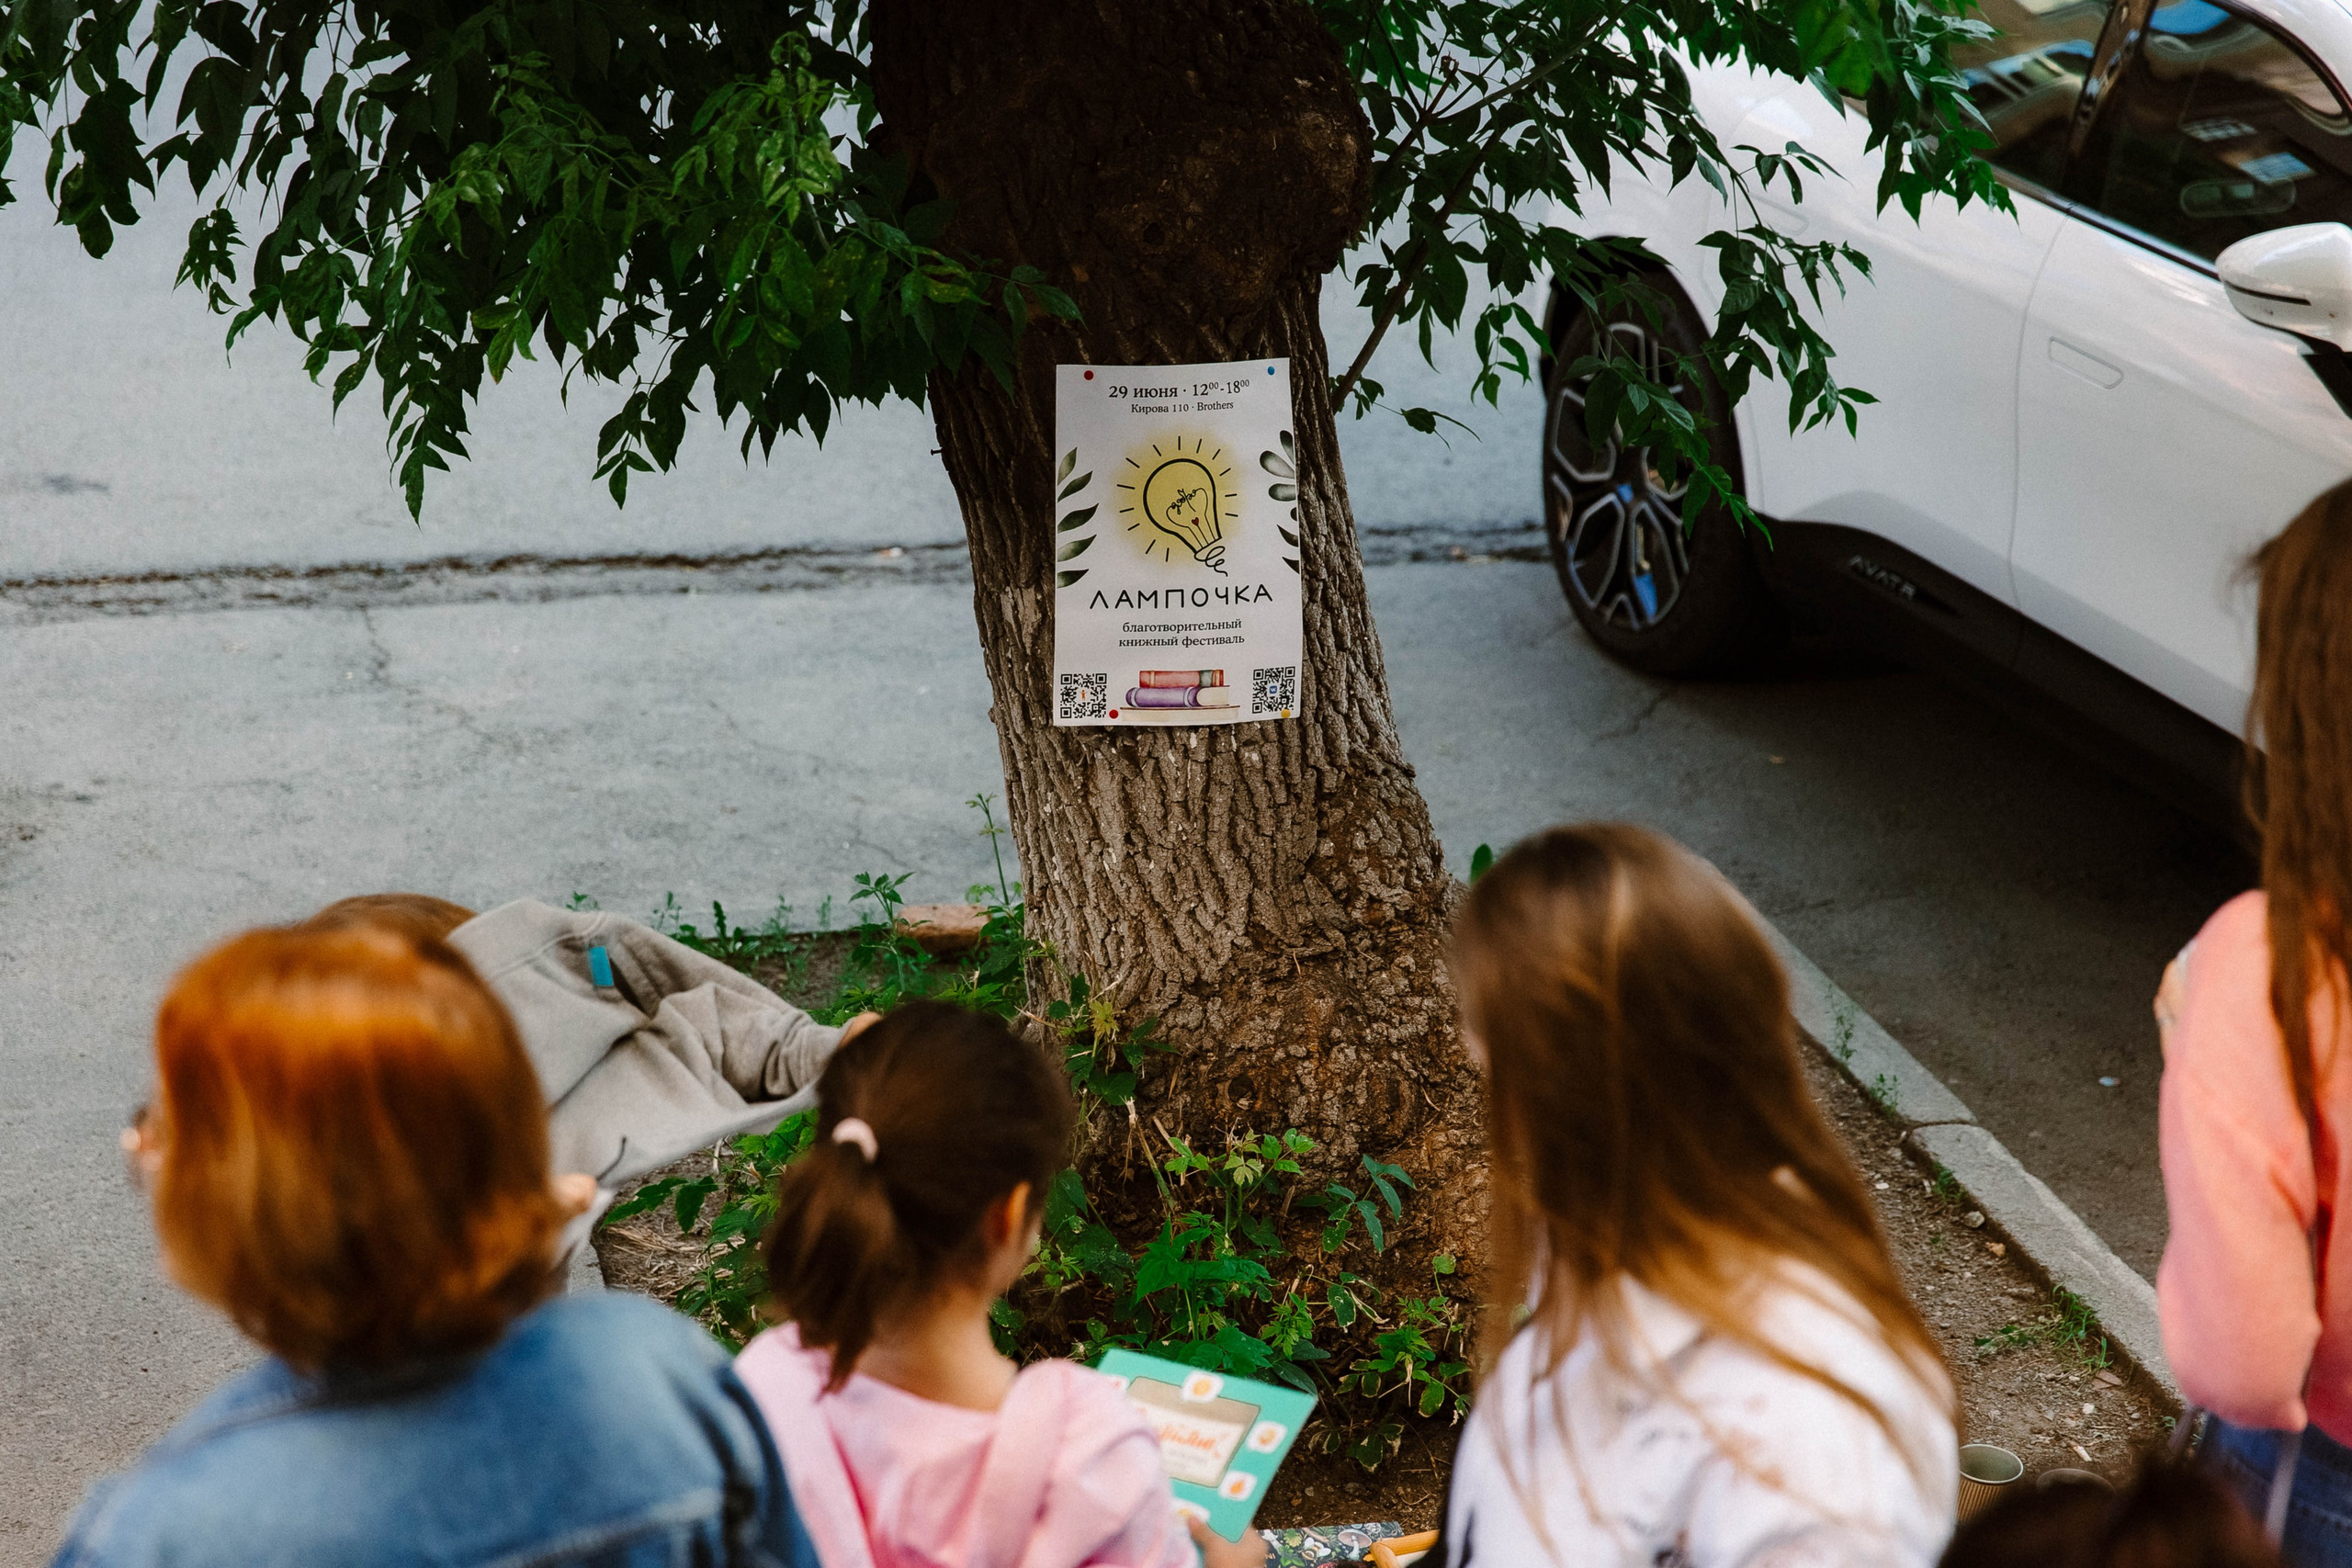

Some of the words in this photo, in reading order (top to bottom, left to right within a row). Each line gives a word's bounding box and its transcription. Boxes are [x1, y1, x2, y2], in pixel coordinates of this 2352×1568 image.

[1108, 385, 1128, 400] 29
[1133, 385, 1179, 399] июня
[1130, 403, 1170, 415] Кирова
[1171, 403, 1189, 412] 110
[1196, 400, 1234, 412] Brothers
[1090, 583, 1273, 610] ЛАМПОЧКА
[1122, 618, 1243, 633] благотворительный
[1118, 636, 1179, 648] книжный
[1182, 635, 1245, 649] фестиваль
